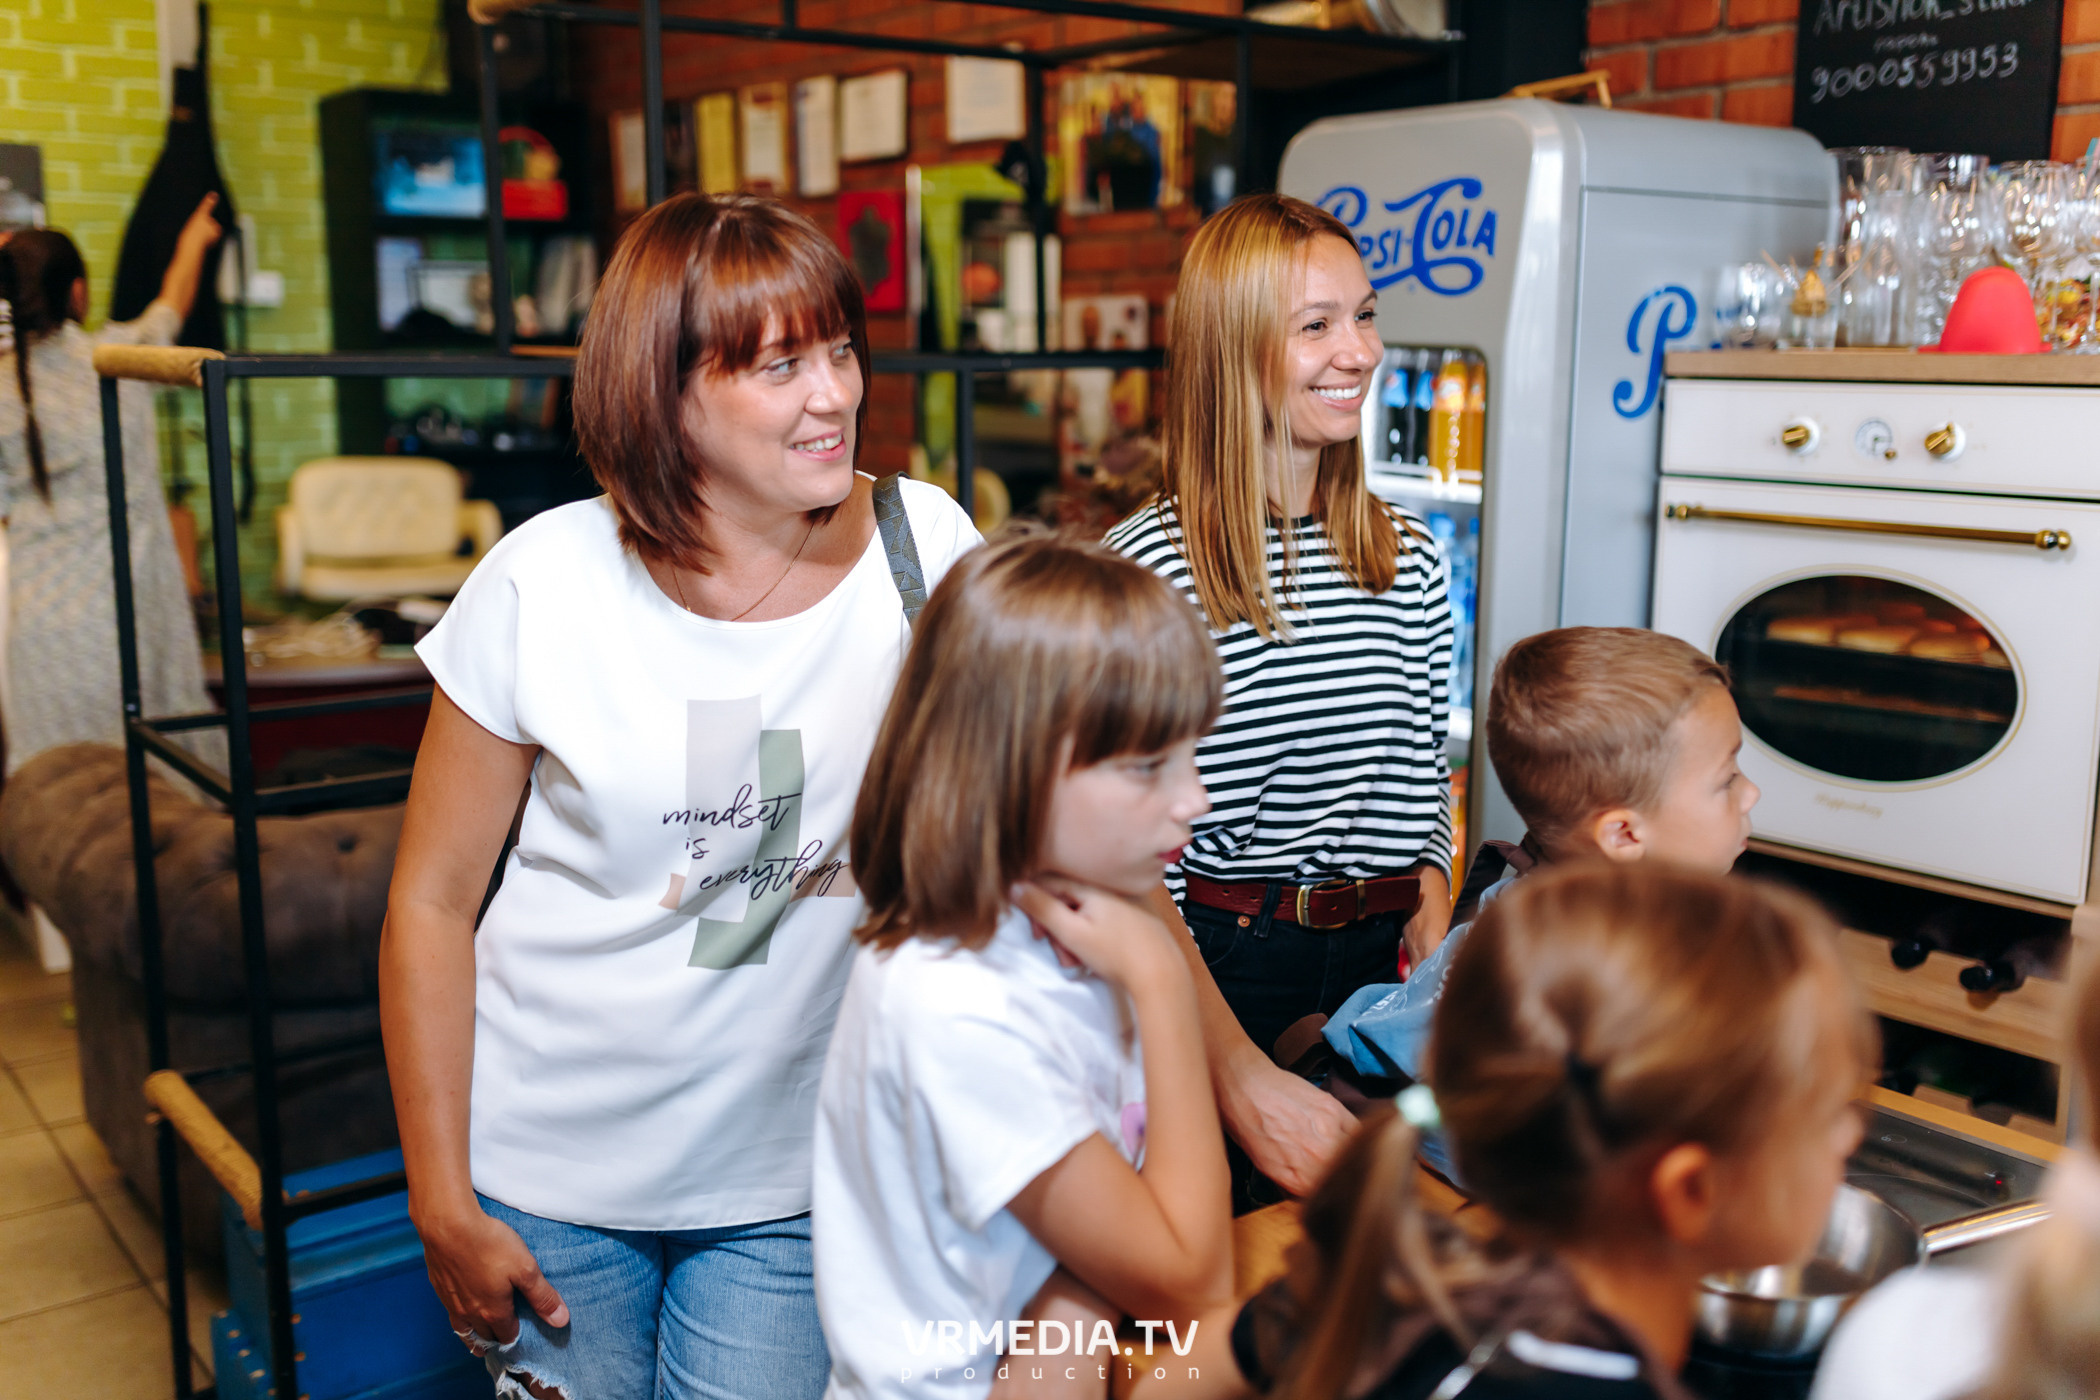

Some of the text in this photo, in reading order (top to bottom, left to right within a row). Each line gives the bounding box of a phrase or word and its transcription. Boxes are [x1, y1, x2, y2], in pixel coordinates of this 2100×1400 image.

[1314, 176, 1498, 296] PPSI-COLA
[662, 783, 803, 831] mindset
[685, 837, 710, 860] is
[699, 839, 849, 901] everything
